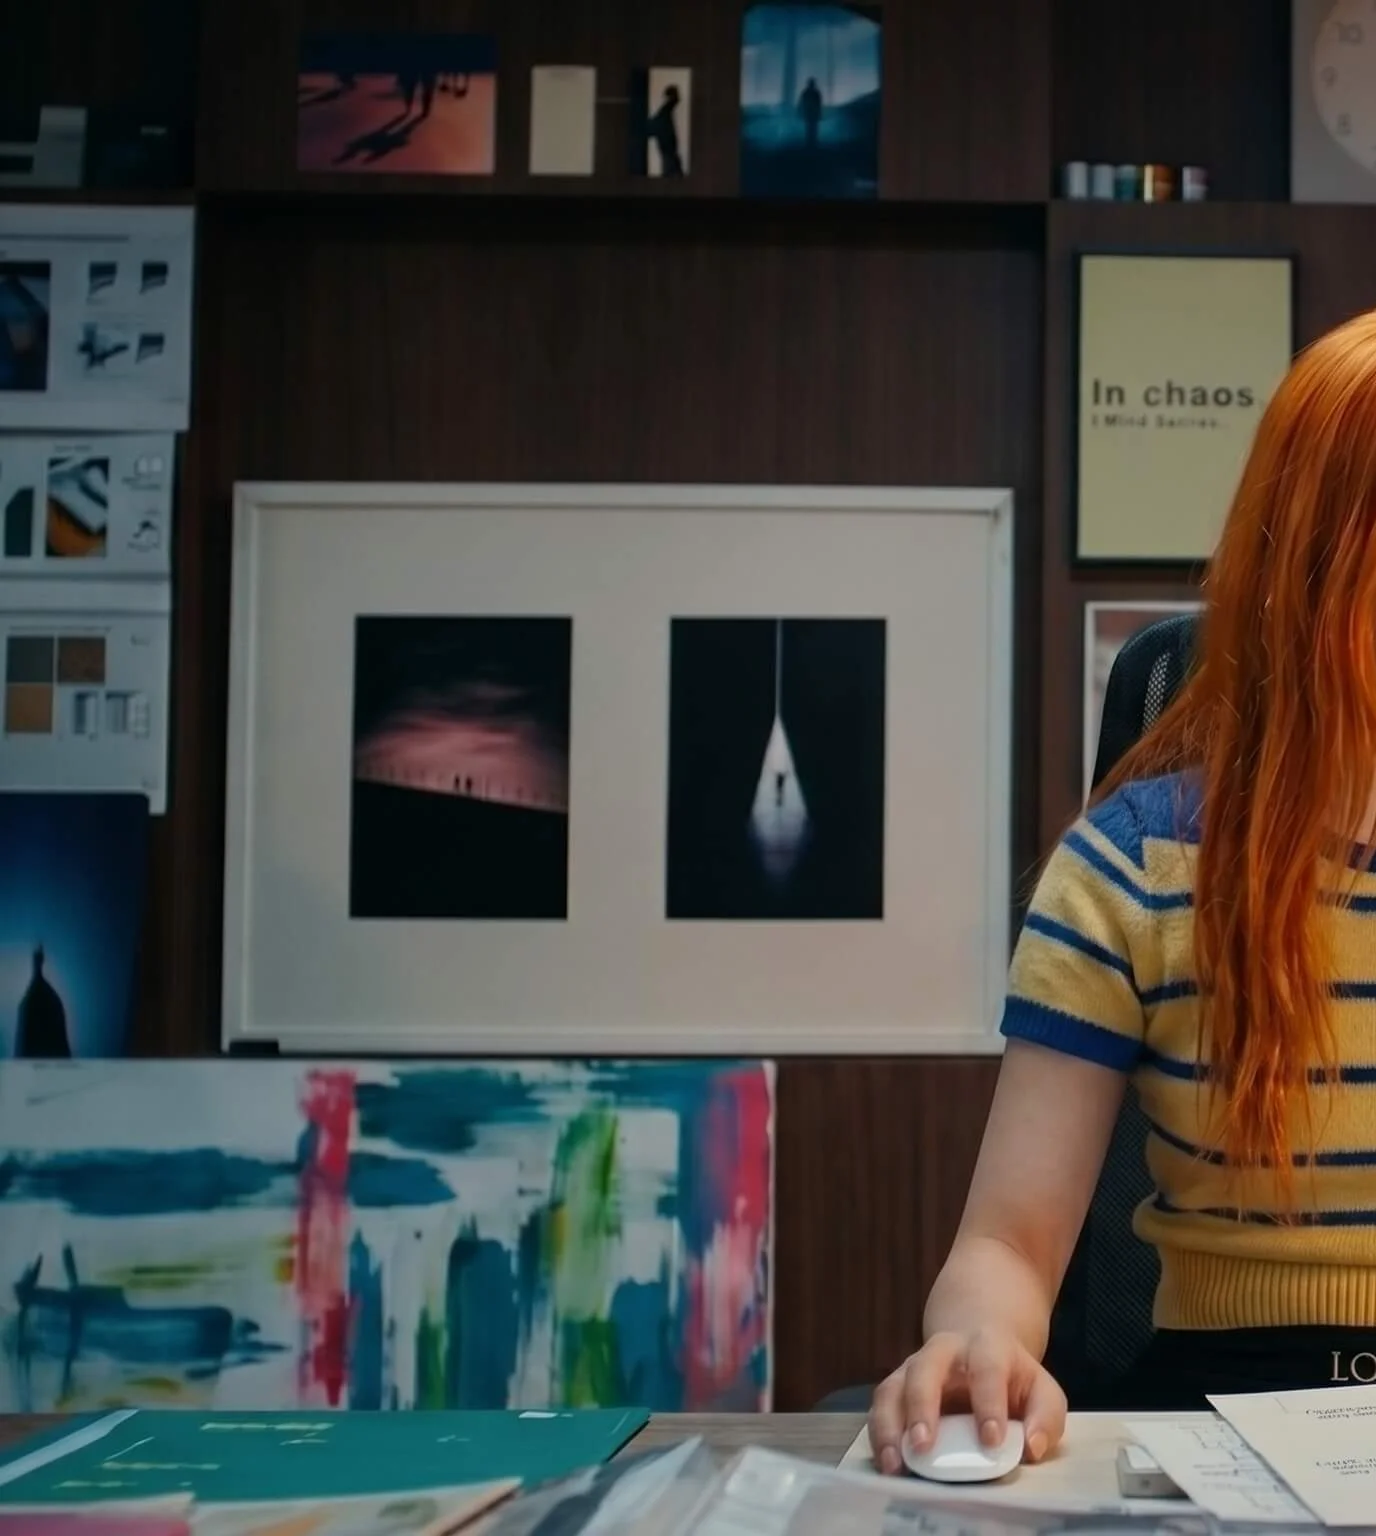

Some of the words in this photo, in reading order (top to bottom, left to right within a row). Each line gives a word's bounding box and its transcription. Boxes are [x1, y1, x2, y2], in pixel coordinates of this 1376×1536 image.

[1334, 21, 1364, 45] 10
[1319, 65, 1338, 88] 9
[1336, 112, 1352, 137] 8
[1092, 378, 1126, 407] In
